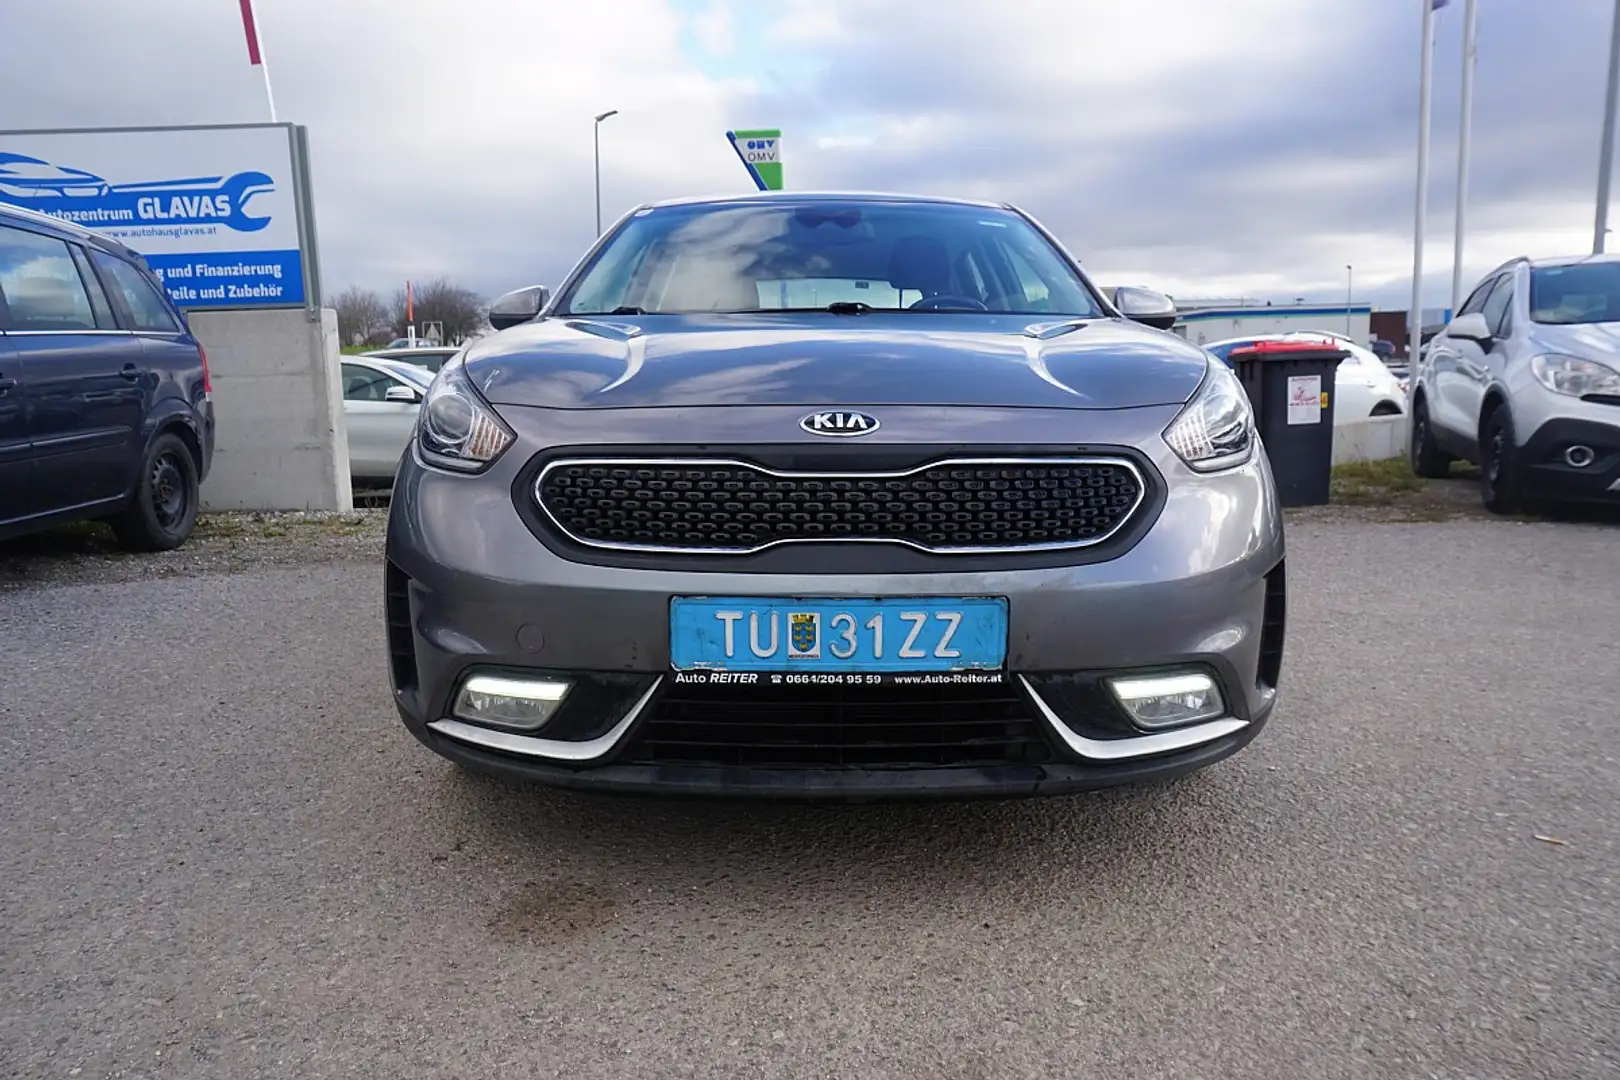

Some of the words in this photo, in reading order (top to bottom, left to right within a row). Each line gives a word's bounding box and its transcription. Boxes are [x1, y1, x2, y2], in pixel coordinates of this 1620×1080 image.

[747, 152, 775, 162] OMV
[137, 194, 231, 219] GLAVAS
[167, 263, 193, 279] und
[195, 262, 282, 279] Finanzierung
[167, 285, 197, 300] eile
[200, 284, 225, 299] und
[228, 283, 283, 298] Zubehör
[814, 413, 868, 429] KIA
[714, 610, 779, 659] TU
[828, 611, 963, 659] 31ZZ
[675, 672, 707, 684] Auto
[709, 673, 759, 684] REITER
[785, 674, 844, 684] 0664/204
[846, 674, 863, 684] 95
[866, 674, 882, 684] 59
[894, 673, 1003, 684] www.Auto-Reiter.at
